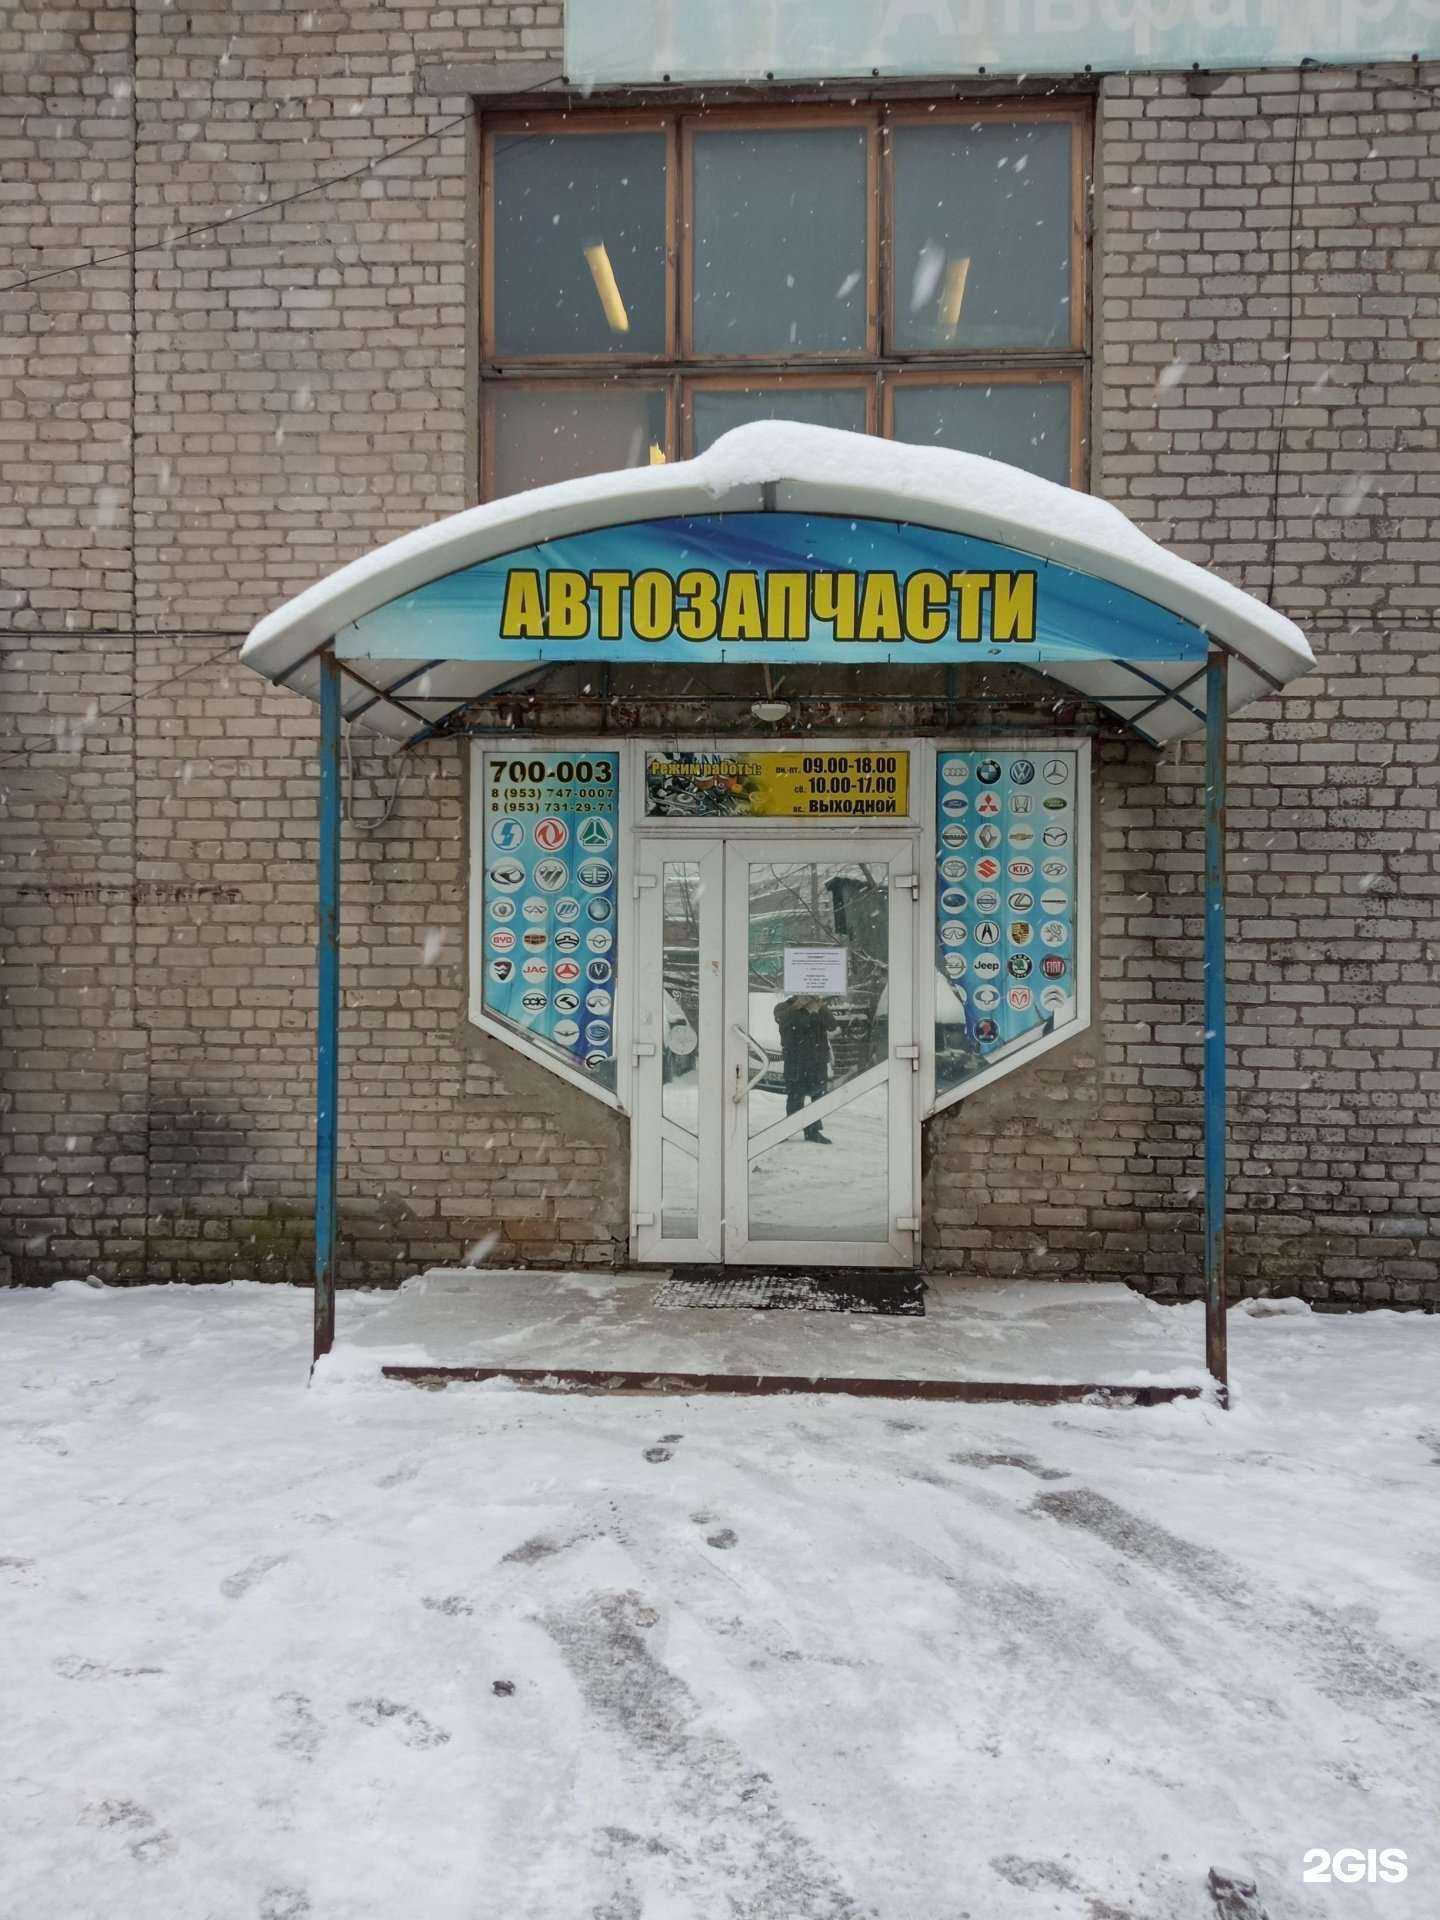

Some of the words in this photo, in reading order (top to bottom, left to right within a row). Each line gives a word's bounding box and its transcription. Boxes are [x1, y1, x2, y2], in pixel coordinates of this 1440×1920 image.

[500, 569, 1038, 642] АВТОЗАПЧАСТИ
[489, 761, 613, 783] 700-003
[803, 757, 896, 774] 09.00-18.00
[808, 777, 896, 794] 10.00-17.00
[491, 789, 499, 798] 8
[504, 788, 542, 800] (953)
[546, 788, 614, 798] 747-0007
[491, 803, 499, 812] 8
[504, 802, 540, 814] (953)
[545, 803, 613, 812] 731-29-71
[808, 796, 896, 814] ВЫХОДНОЙ
[1013, 864, 1030, 873] KIA
[523, 966, 547, 974] JAC
[974, 961, 999, 971] Jeep
